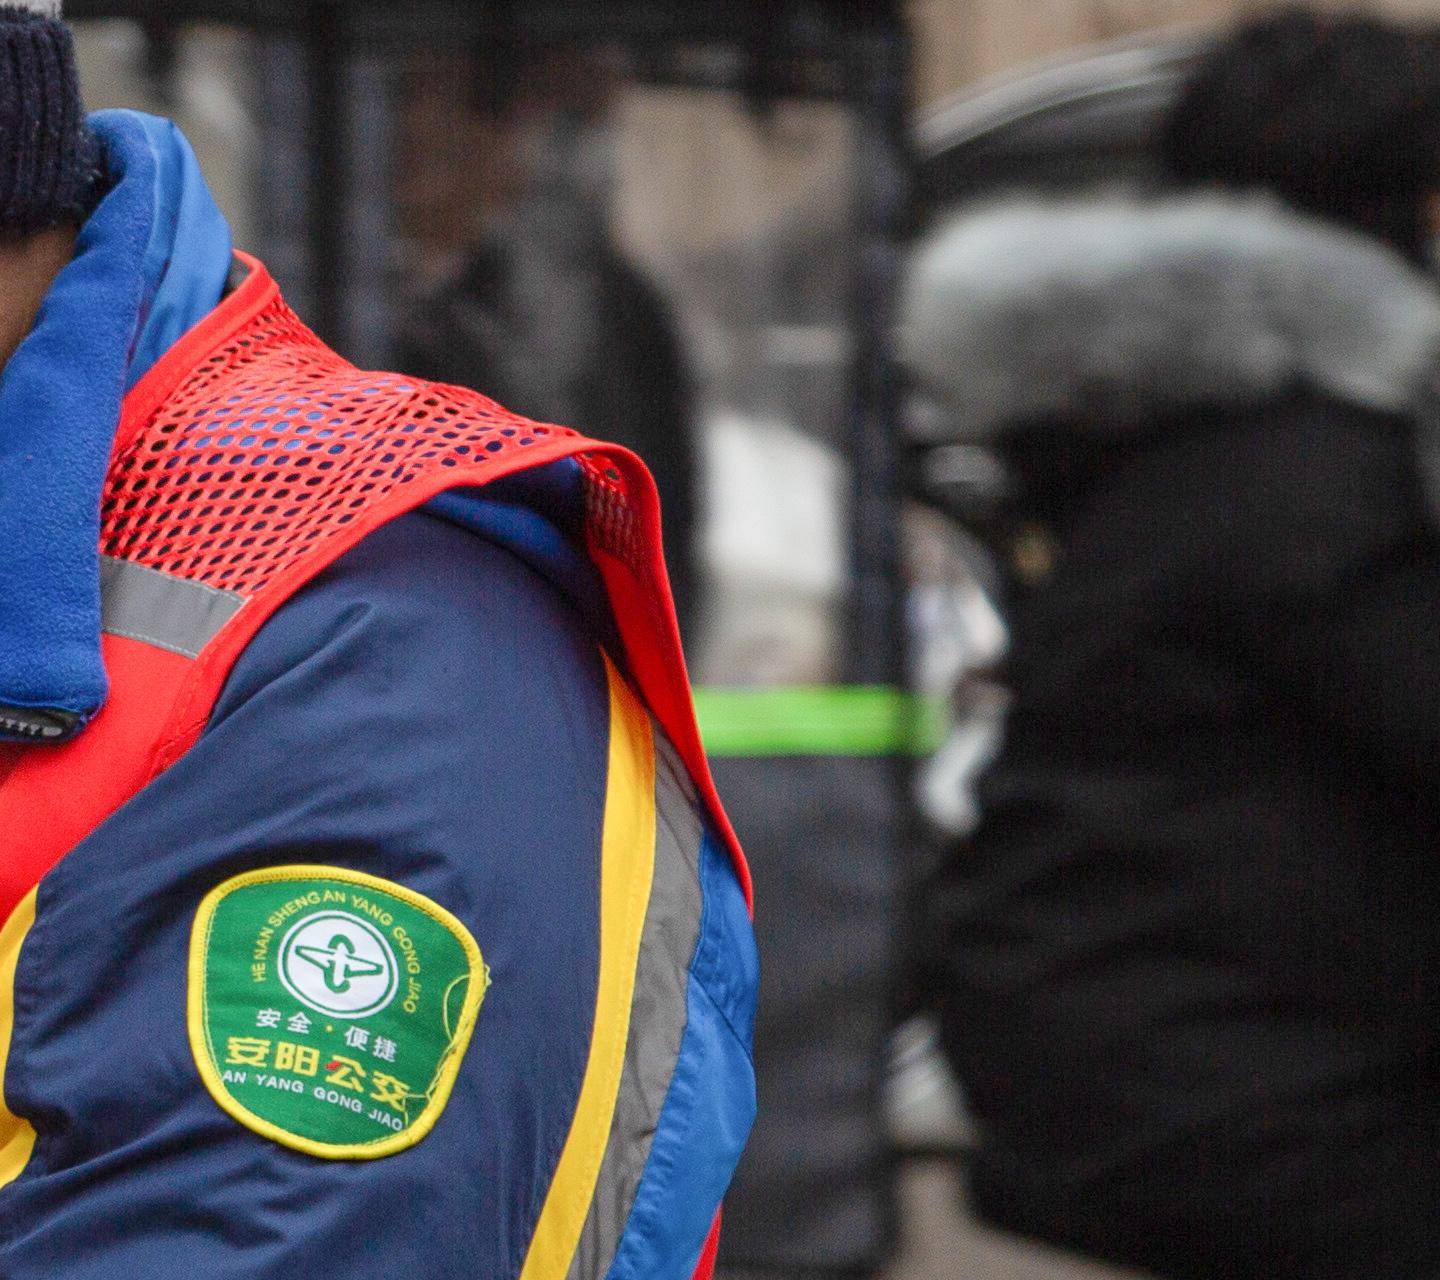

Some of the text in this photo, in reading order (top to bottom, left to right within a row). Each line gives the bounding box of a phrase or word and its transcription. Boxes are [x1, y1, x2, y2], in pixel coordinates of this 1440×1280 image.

[323, 890, 347, 903] AN
[351, 894, 394, 926] YANG
[392, 926, 421, 974] GONG
[222, 1069, 404, 1131] AN YANG GONG JIAO
[225, 1036, 410, 1113] 安阳公交
